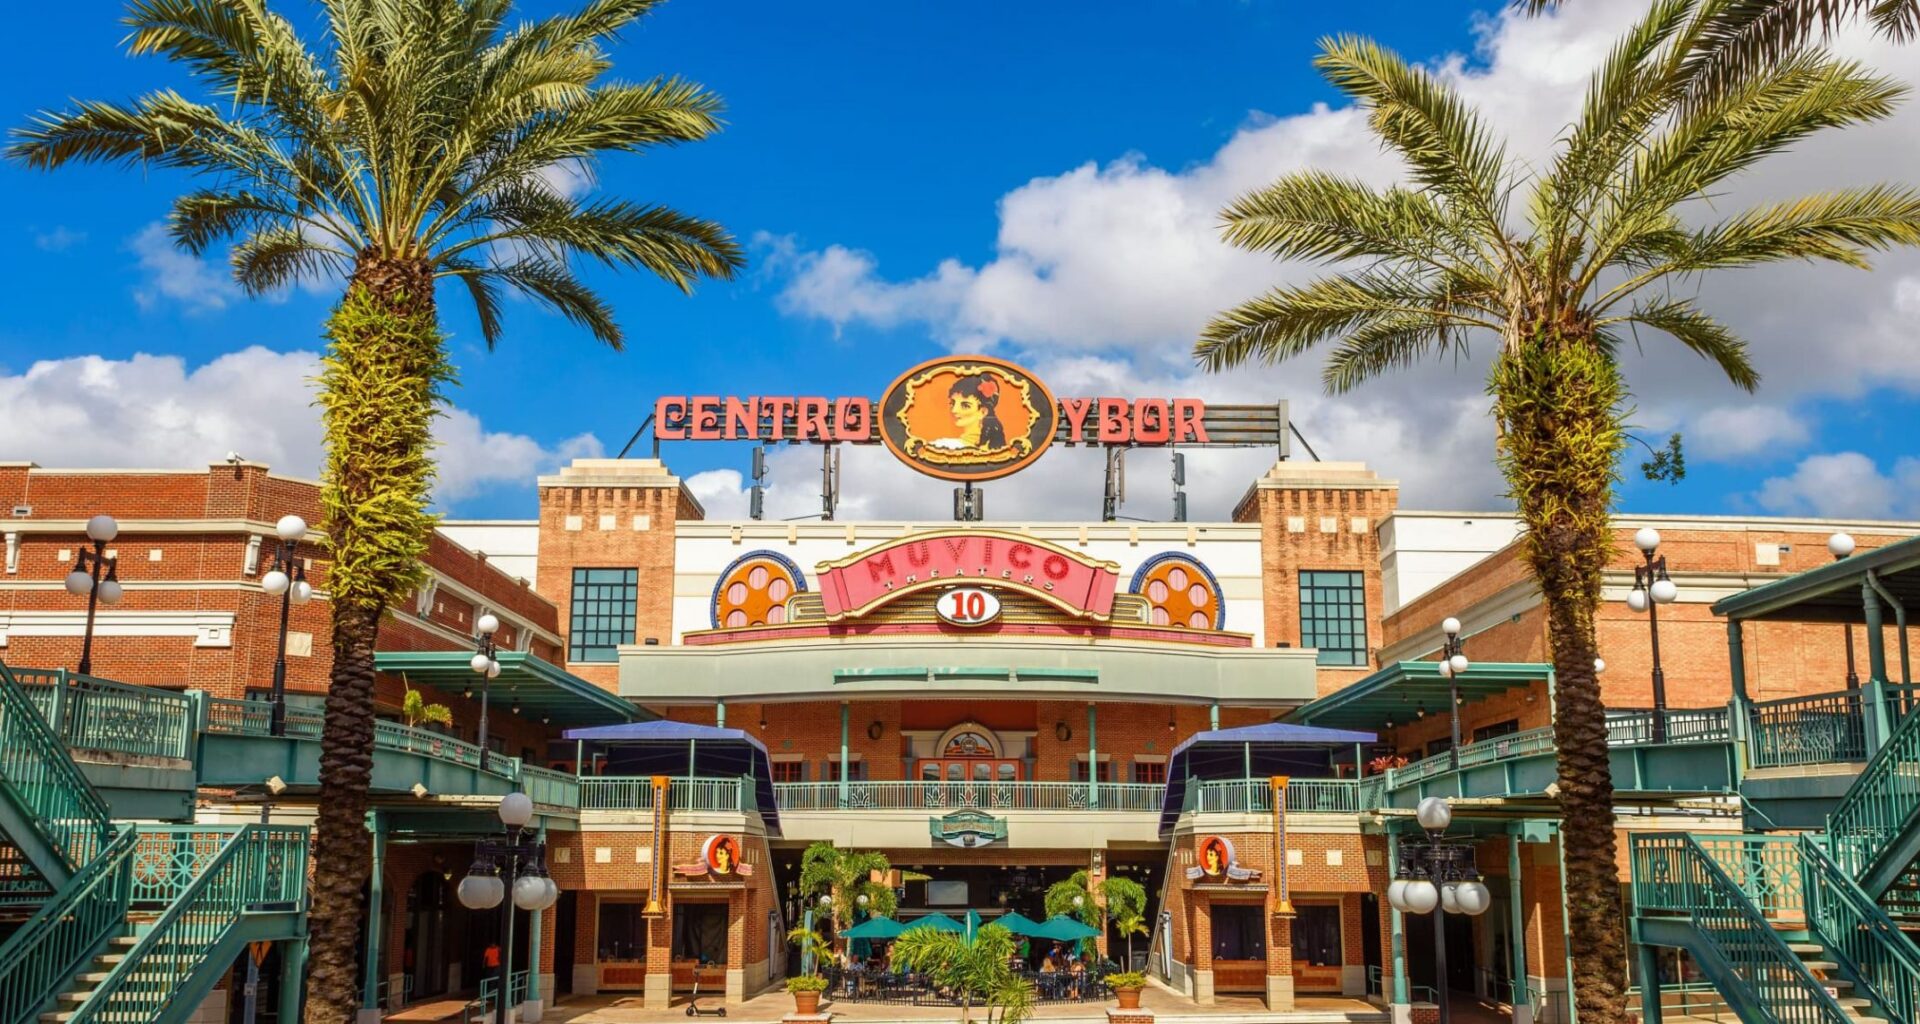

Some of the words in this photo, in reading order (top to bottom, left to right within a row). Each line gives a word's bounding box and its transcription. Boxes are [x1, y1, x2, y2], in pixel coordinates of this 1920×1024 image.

[655, 395, 871, 441] CENTRO
[1058, 396, 1211, 442] YBOR
[867, 538, 1069, 583] MUVICO
[884, 567, 1055, 591] THEATERS
[950, 591, 986, 621] 10
